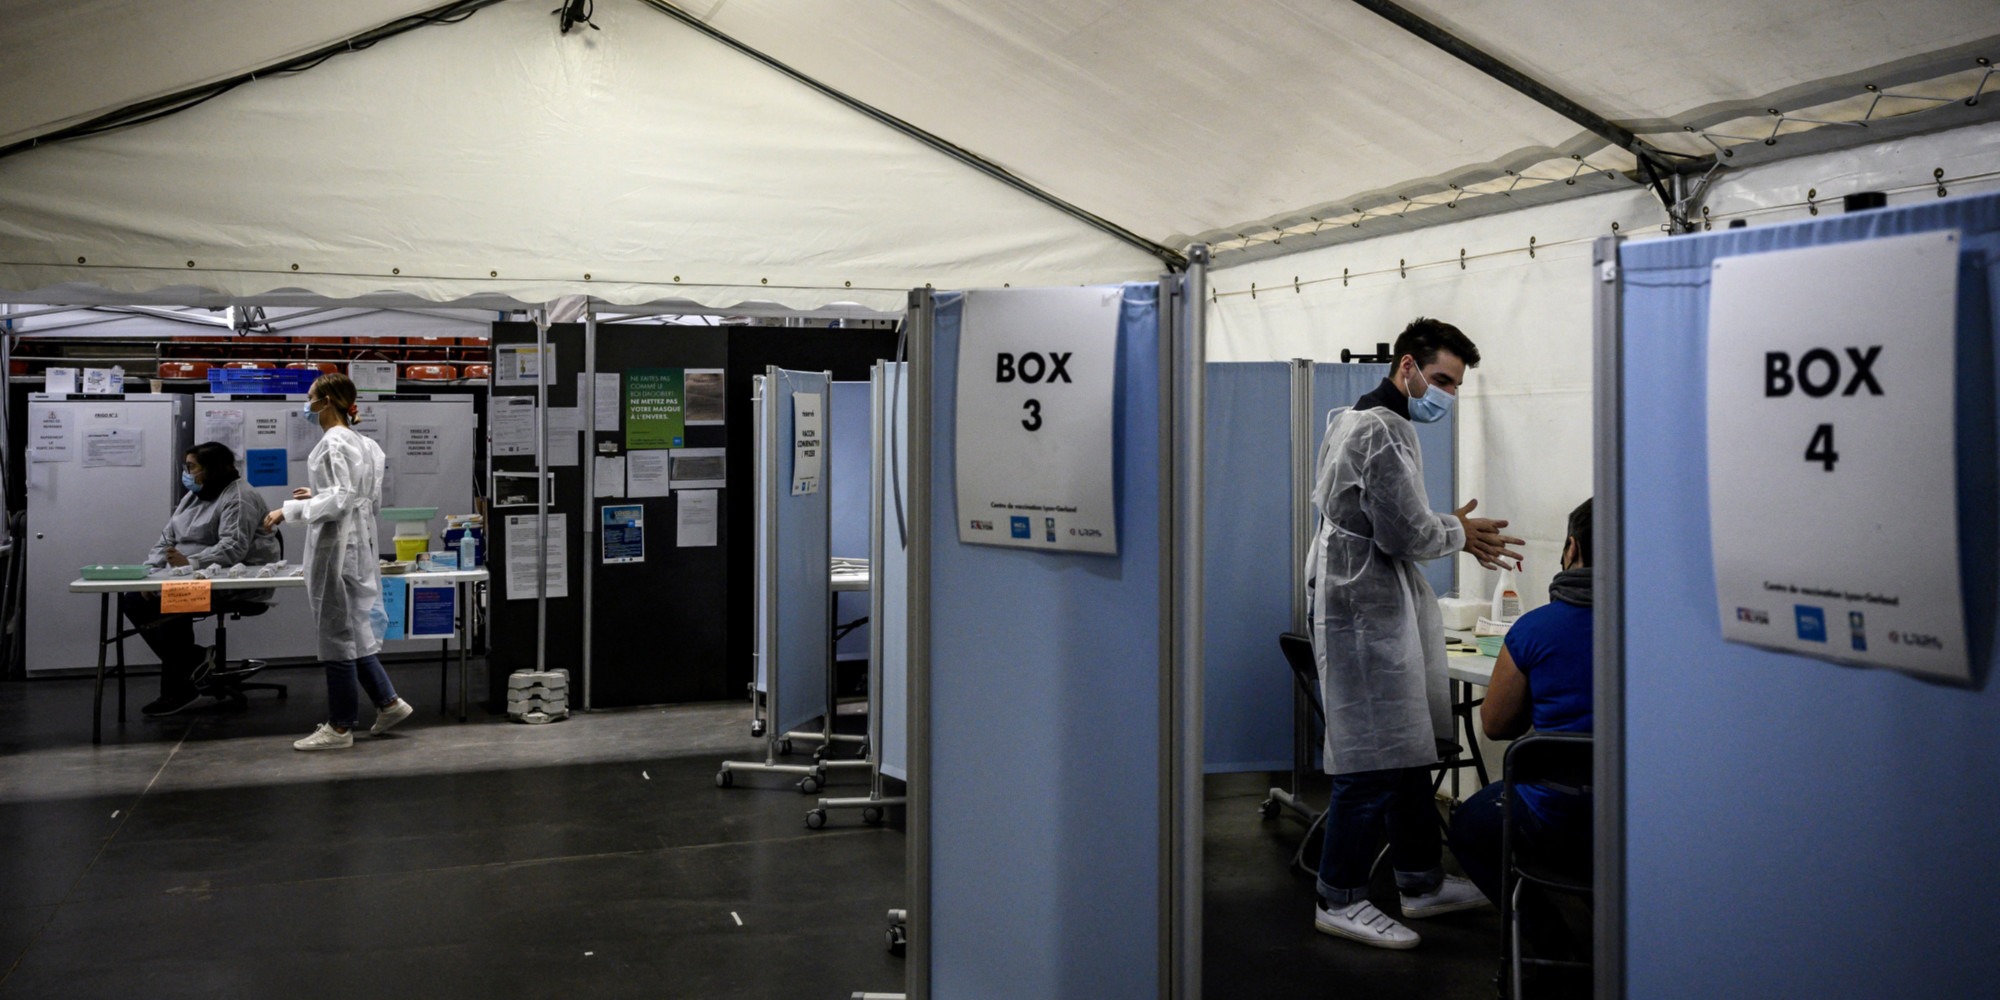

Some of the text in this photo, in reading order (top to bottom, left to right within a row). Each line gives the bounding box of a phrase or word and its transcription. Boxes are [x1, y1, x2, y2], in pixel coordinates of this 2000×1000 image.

[996, 351, 1073, 384] BOX
[1764, 344, 1885, 399] BOX
[1021, 398, 1043, 432] 3
[1804, 422, 1839, 473] 4
[1015, 503, 1042, 511] vaccination
[1789, 585, 1798, 594] de
